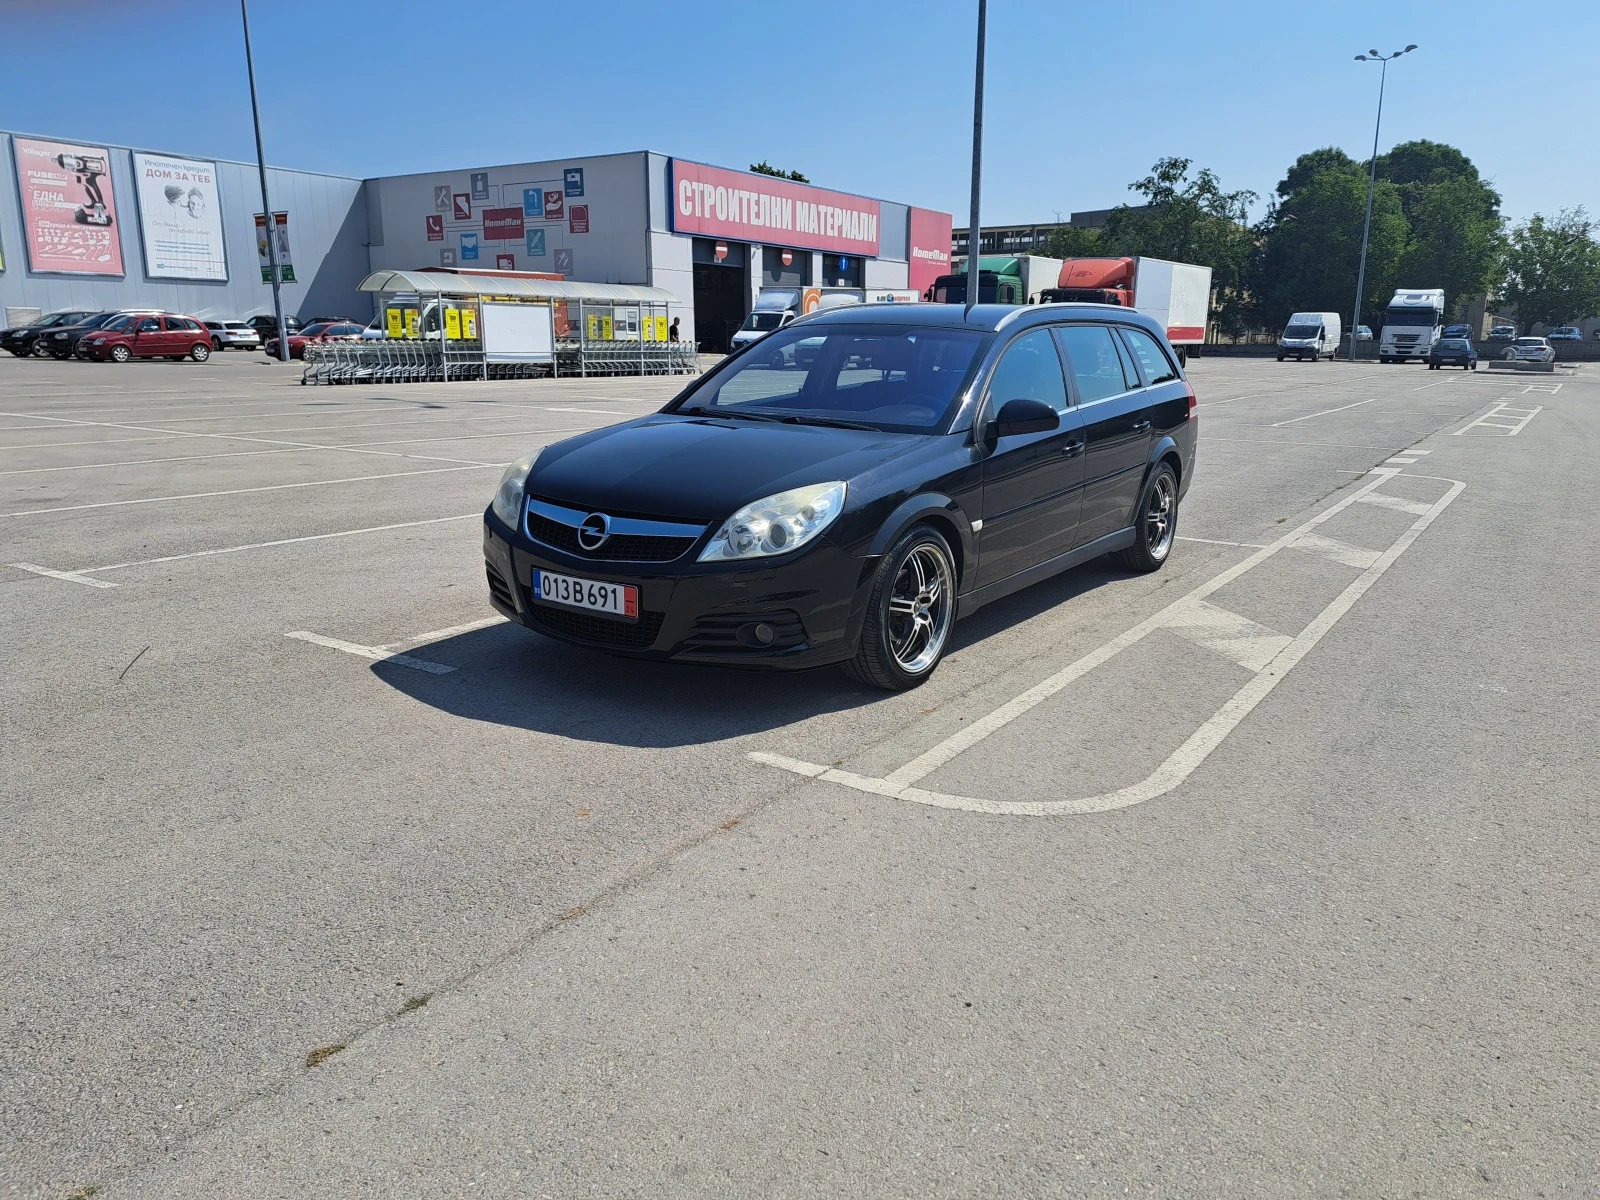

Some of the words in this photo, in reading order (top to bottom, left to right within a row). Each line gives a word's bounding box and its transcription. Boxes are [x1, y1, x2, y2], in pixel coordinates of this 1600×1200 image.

[22, 147, 50, 157] Villager
[144, 159, 182, 170] Ипотечен
[183, 163, 210, 174] кредит
[27, 170, 54, 179] FUSE
[146, 168, 172, 179] ДОМ
[174, 171, 189, 181] ЗА
[191, 173, 211, 184] ТЕБ
[33, 190, 64, 202] ЕДНА
[678, 179, 792, 231] СТРОИТЕЛНИ
[796, 200, 877, 243] МАТЕРИАЛИ
[543, 575, 618, 610] 013B691
